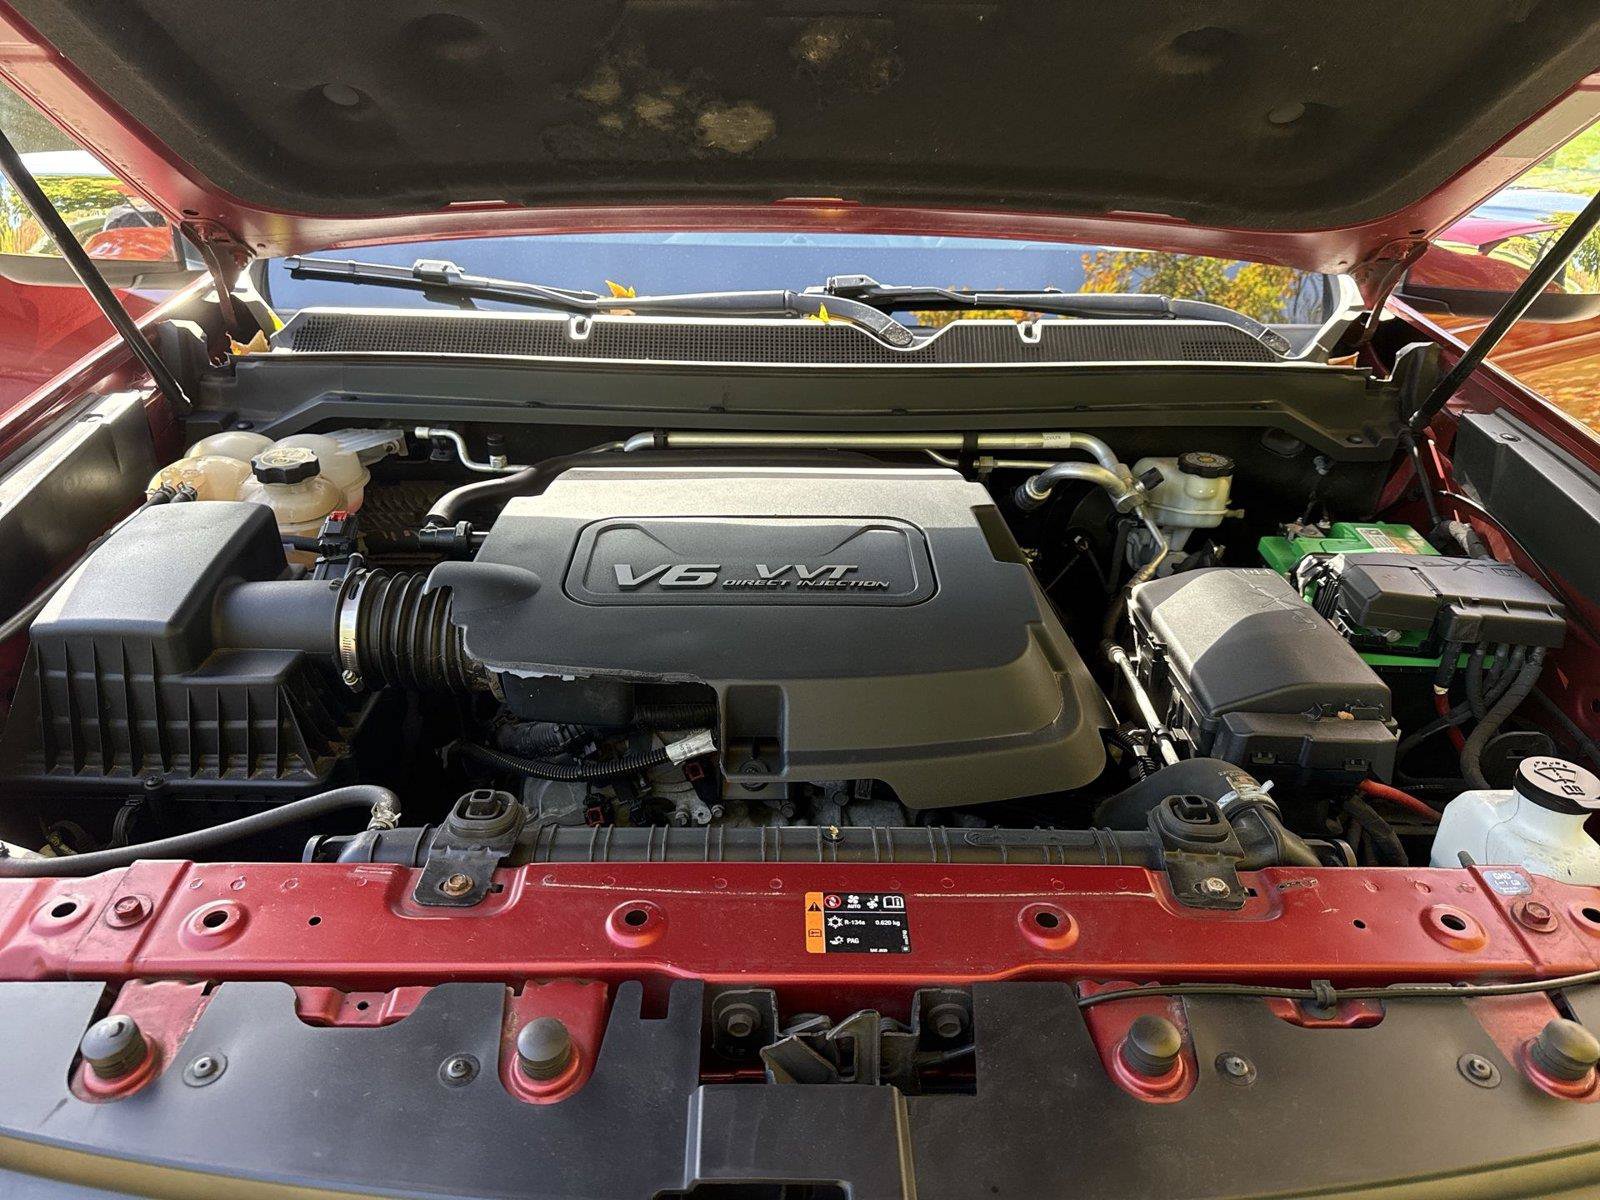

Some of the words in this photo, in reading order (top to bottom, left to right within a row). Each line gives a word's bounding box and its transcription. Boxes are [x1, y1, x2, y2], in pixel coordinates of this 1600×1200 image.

[614, 564, 722, 588] V6
[755, 564, 858, 579] VVT
[722, 579, 791, 588] DIRECT
[796, 580, 890, 588] INJECTION
